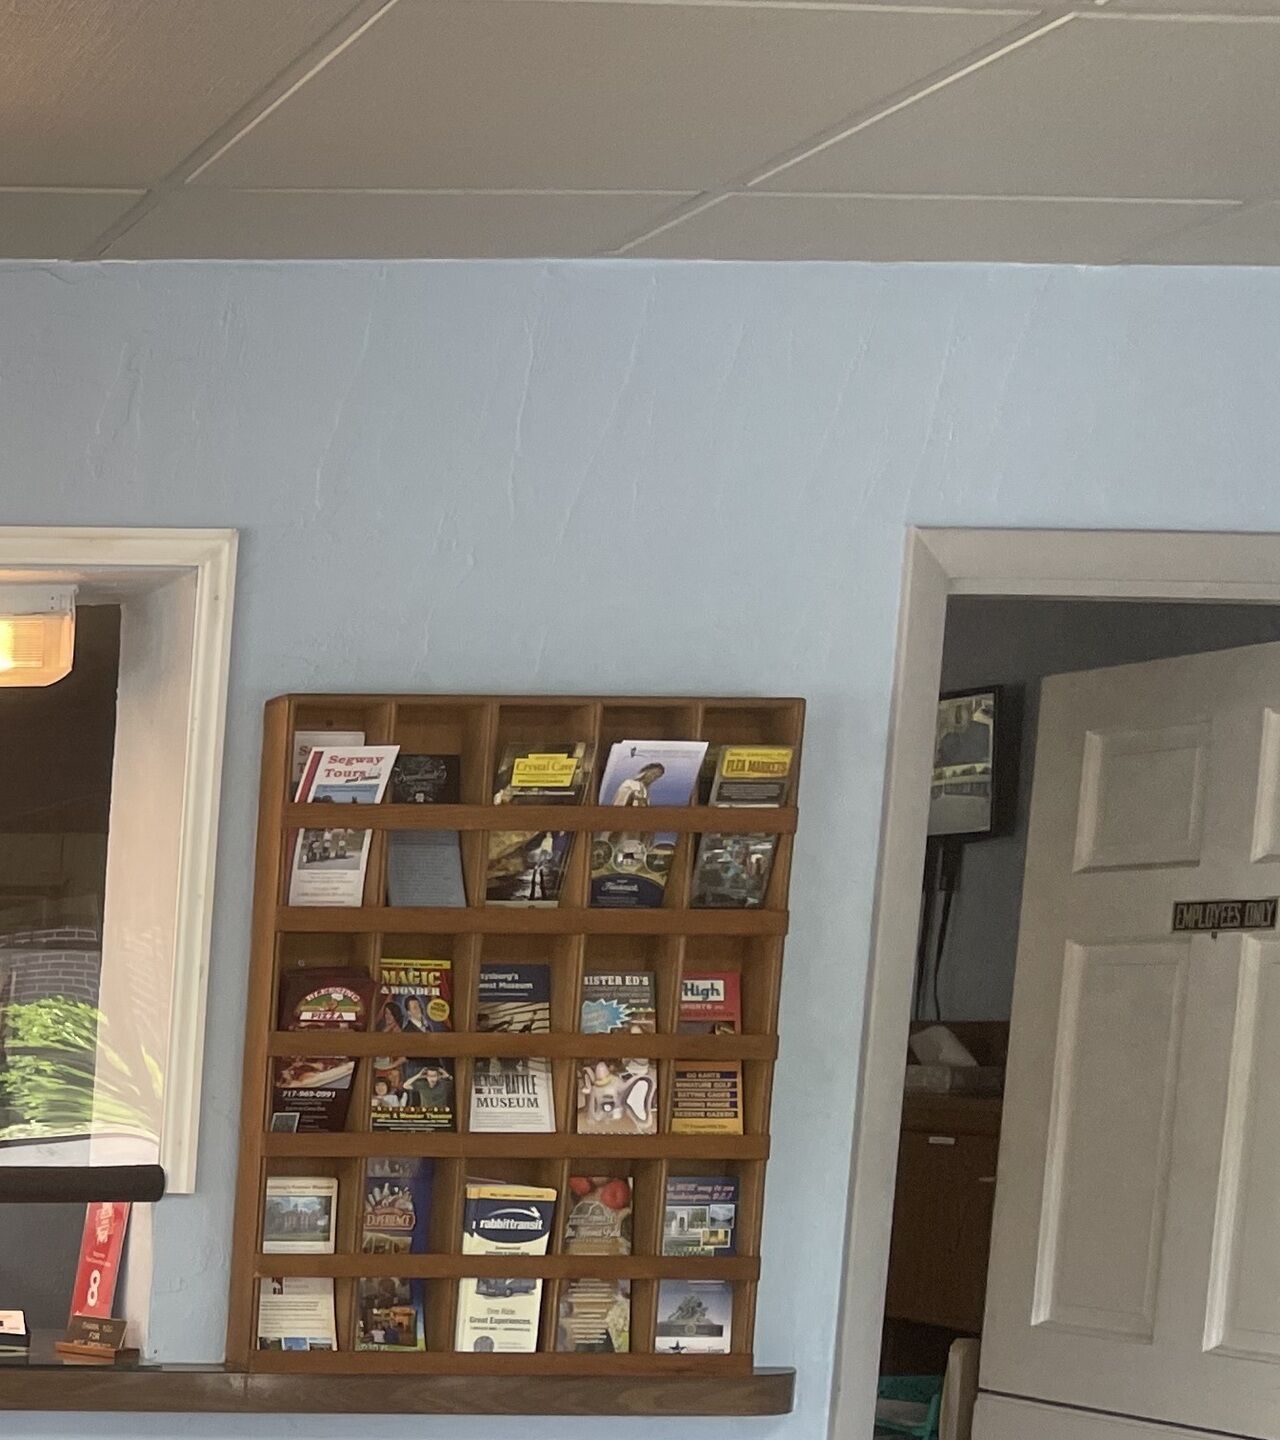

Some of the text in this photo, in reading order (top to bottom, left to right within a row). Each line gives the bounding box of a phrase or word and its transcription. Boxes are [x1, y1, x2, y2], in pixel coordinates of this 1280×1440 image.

[328, 755, 385, 767] Segway
[515, 760, 575, 773] Crystal Cave
[725, 759, 745, 773] FLEA
[324, 768, 367, 779] Tours
[1174, 901, 1275, 929] EMPLOYEES ONLY
[380, 969, 441, 987] MAGIC
[625, 975, 650, 987] ED'S
[380, 986, 441, 997] & WONDER
[498, 981, 534, 990] Museum
[682, 982, 721, 1000] High
[310, 1012, 345, 1021] PIZZA
[505, 1074, 538, 1095] BATTLE
[476, 1097, 540, 1109] MUSEUM
[366, 1213, 411, 1227] EXPERIENCE
[479, 1217, 544, 1231] rabbittransit
[469, 1316, 489, 1325] Great
